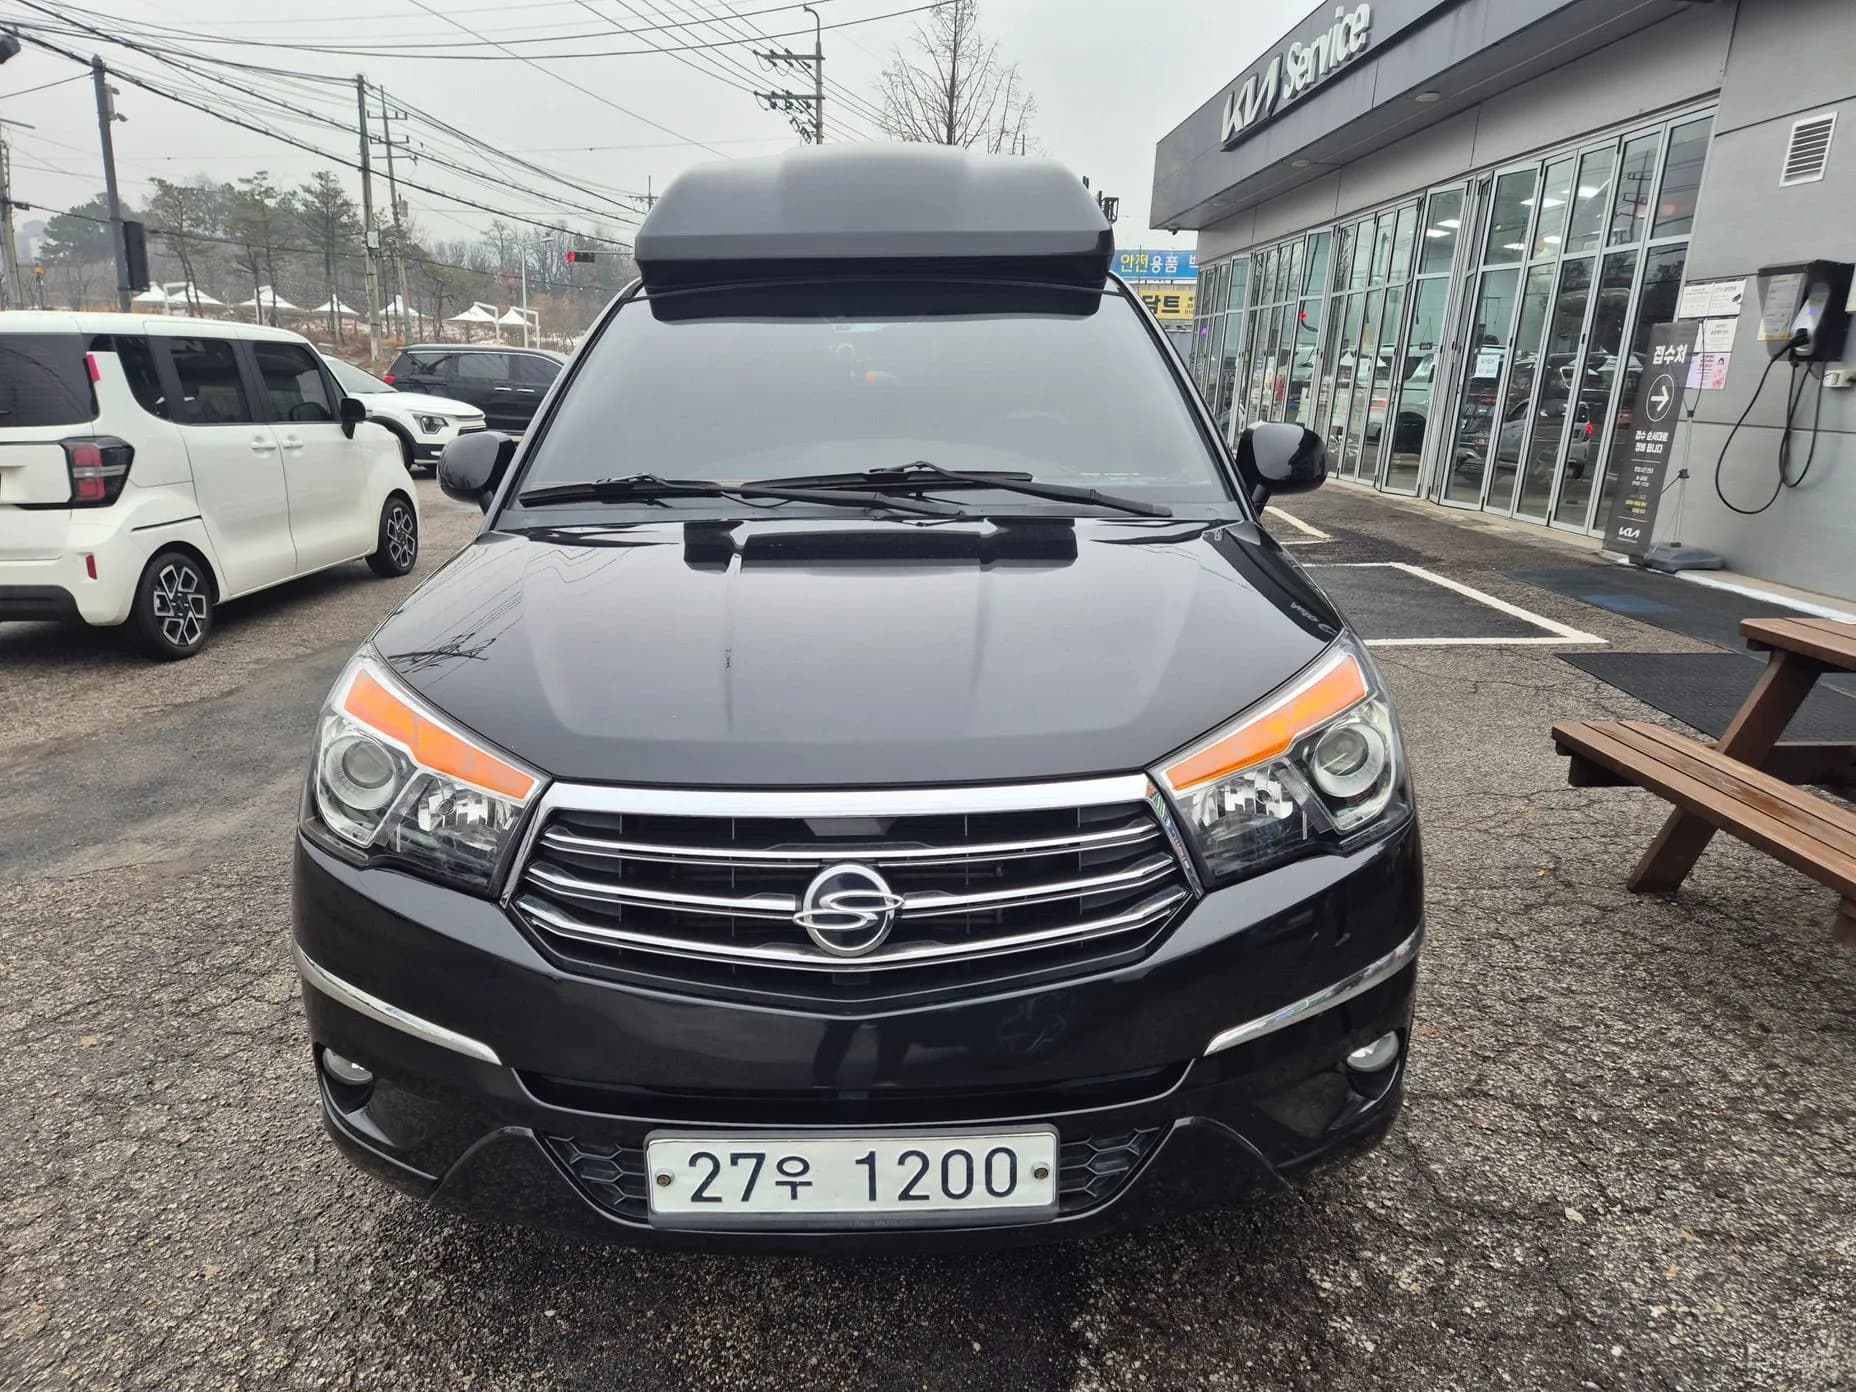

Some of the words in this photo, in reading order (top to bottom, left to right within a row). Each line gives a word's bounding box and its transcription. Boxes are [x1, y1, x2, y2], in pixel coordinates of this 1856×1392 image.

[1221, 56, 1282, 143] KIA
[1283, 3, 1371, 100] Service
[1120, 254, 1179, 273] 안전용품
[1653, 344, 1688, 365] 접수처
[688, 1151, 813, 1203] 27우
[854, 1147, 1018, 1202] 1200
